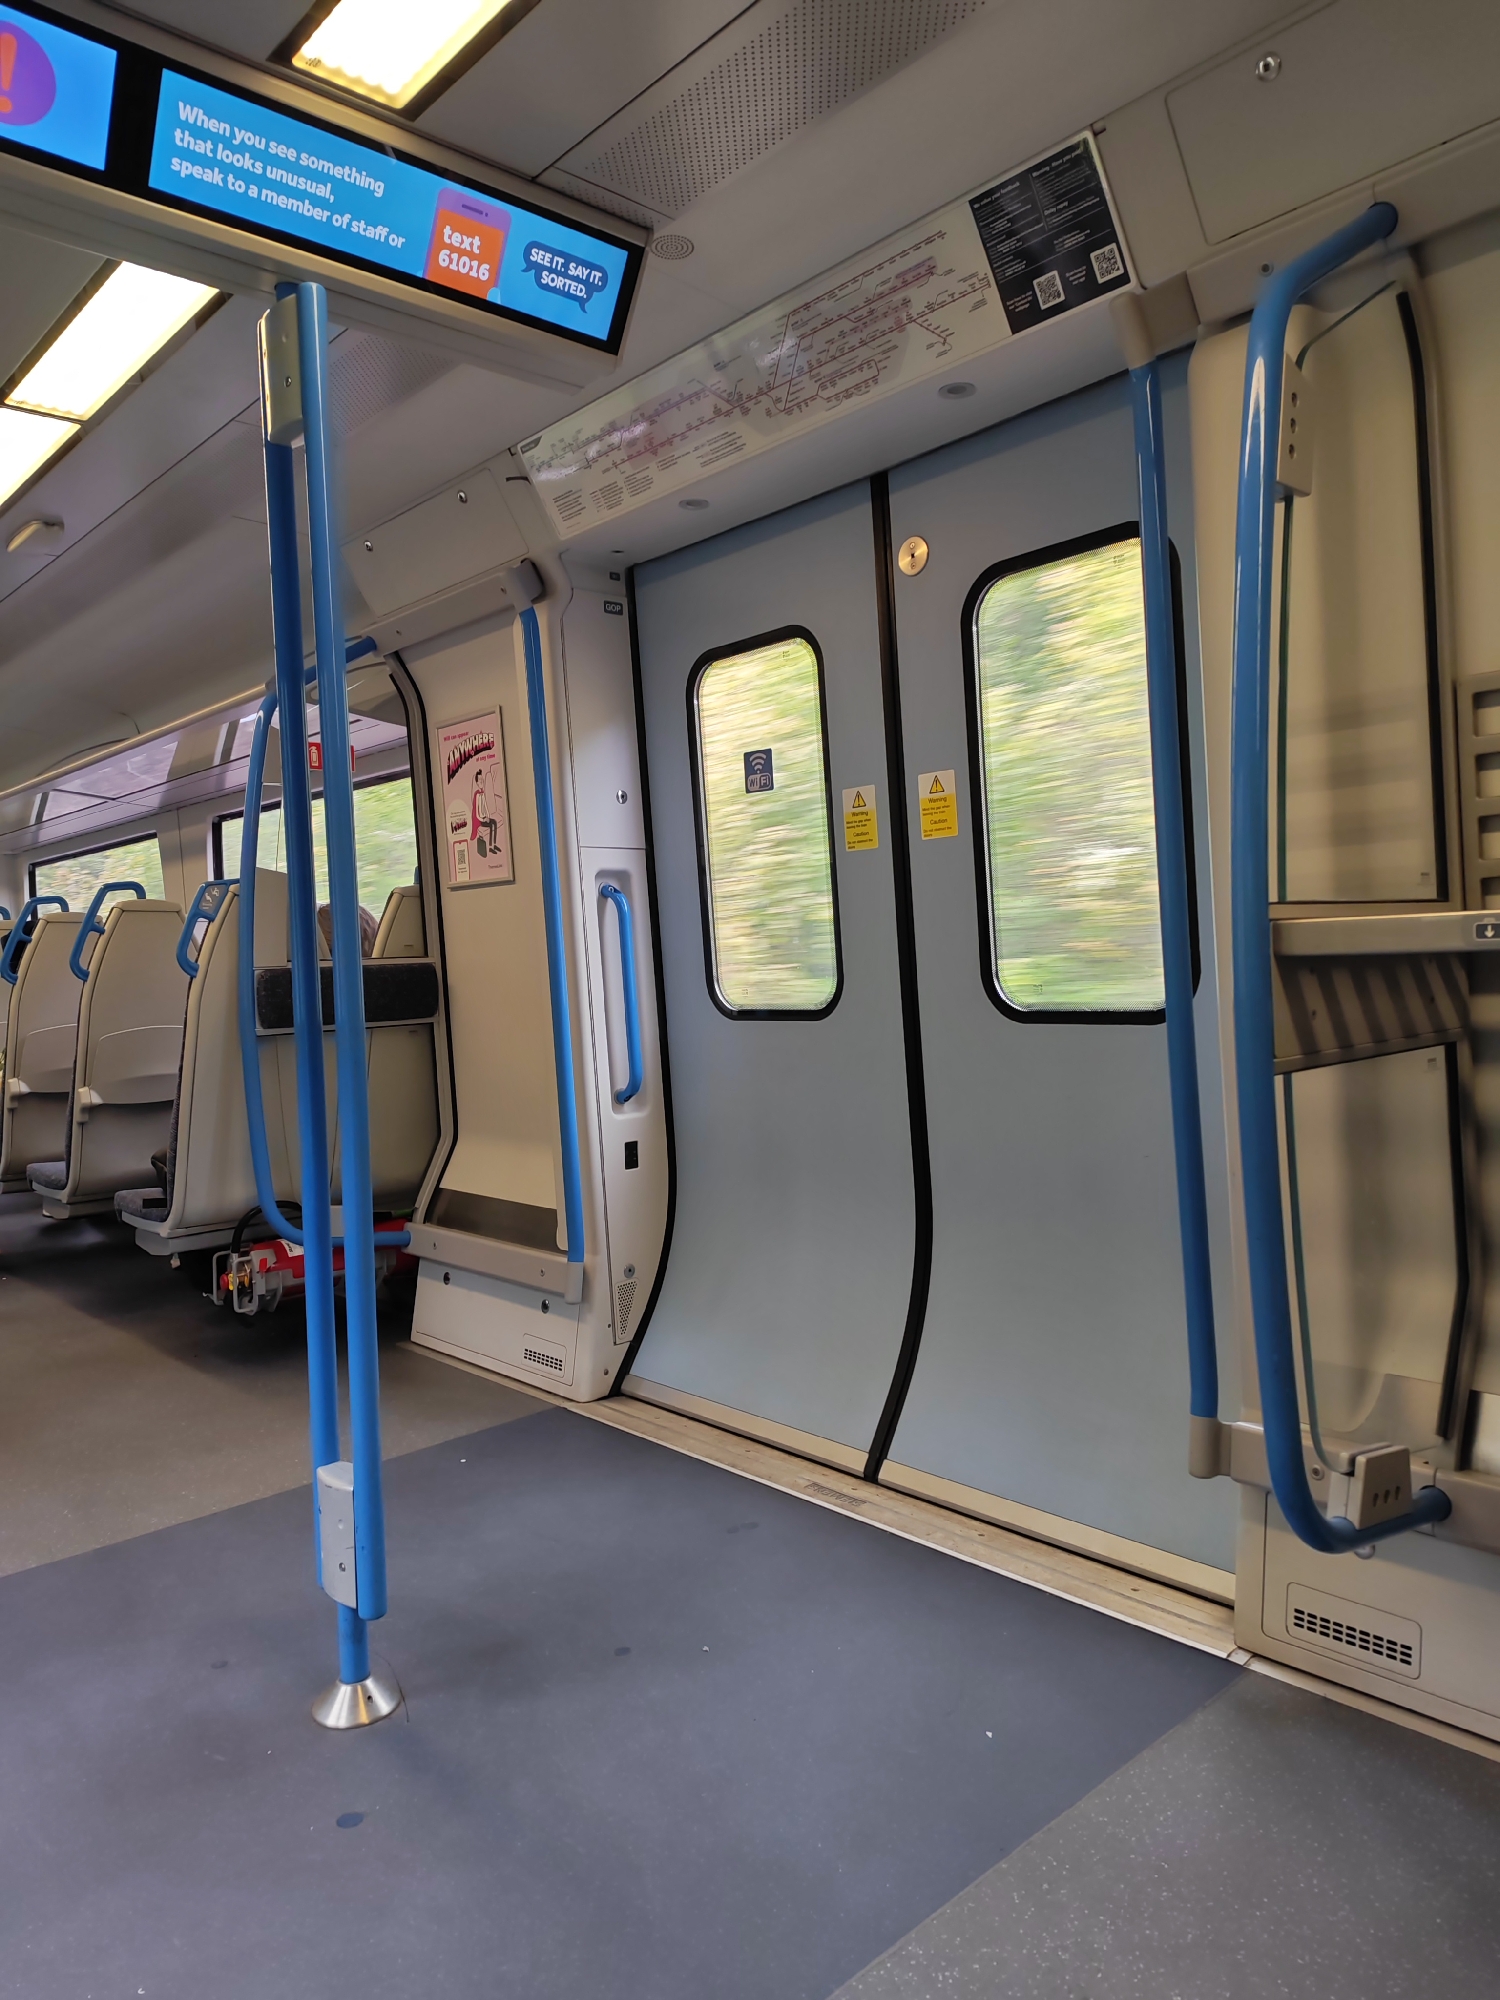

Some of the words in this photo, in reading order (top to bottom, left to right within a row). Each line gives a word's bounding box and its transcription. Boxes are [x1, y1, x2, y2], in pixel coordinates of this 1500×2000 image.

[174, 128, 214, 157] that
[216, 142, 264, 174] looks
[266, 165, 334, 203] unusual,
[178, 100, 231, 138] When
[232, 126, 266, 151] you
[268, 141, 297, 162] see
[299, 152, 385, 198] something
[170, 157, 225, 187] speak
[227, 172, 246, 193] to
[247, 184, 259, 199] a
[260, 188, 331, 222] member
[332, 213, 352, 230] of
[350, 219, 389, 242] staff
[388, 233, 406, 249] or
[443, 225, 481, 254] text
[438, 249, 490, 281] 61016
[529, 247, 553, 268] SEE
[551, 256, 565, 272] IT.
[567, 261, 591, 281] SAY
[589, 270, 603, 286] IT.
[540, 270, 587, 299] SORTED.
[605, 603, 622, 612] GOP
[447, 732, 495, 785] ANYWHERE
[928, 796, 948, 804] Warning
